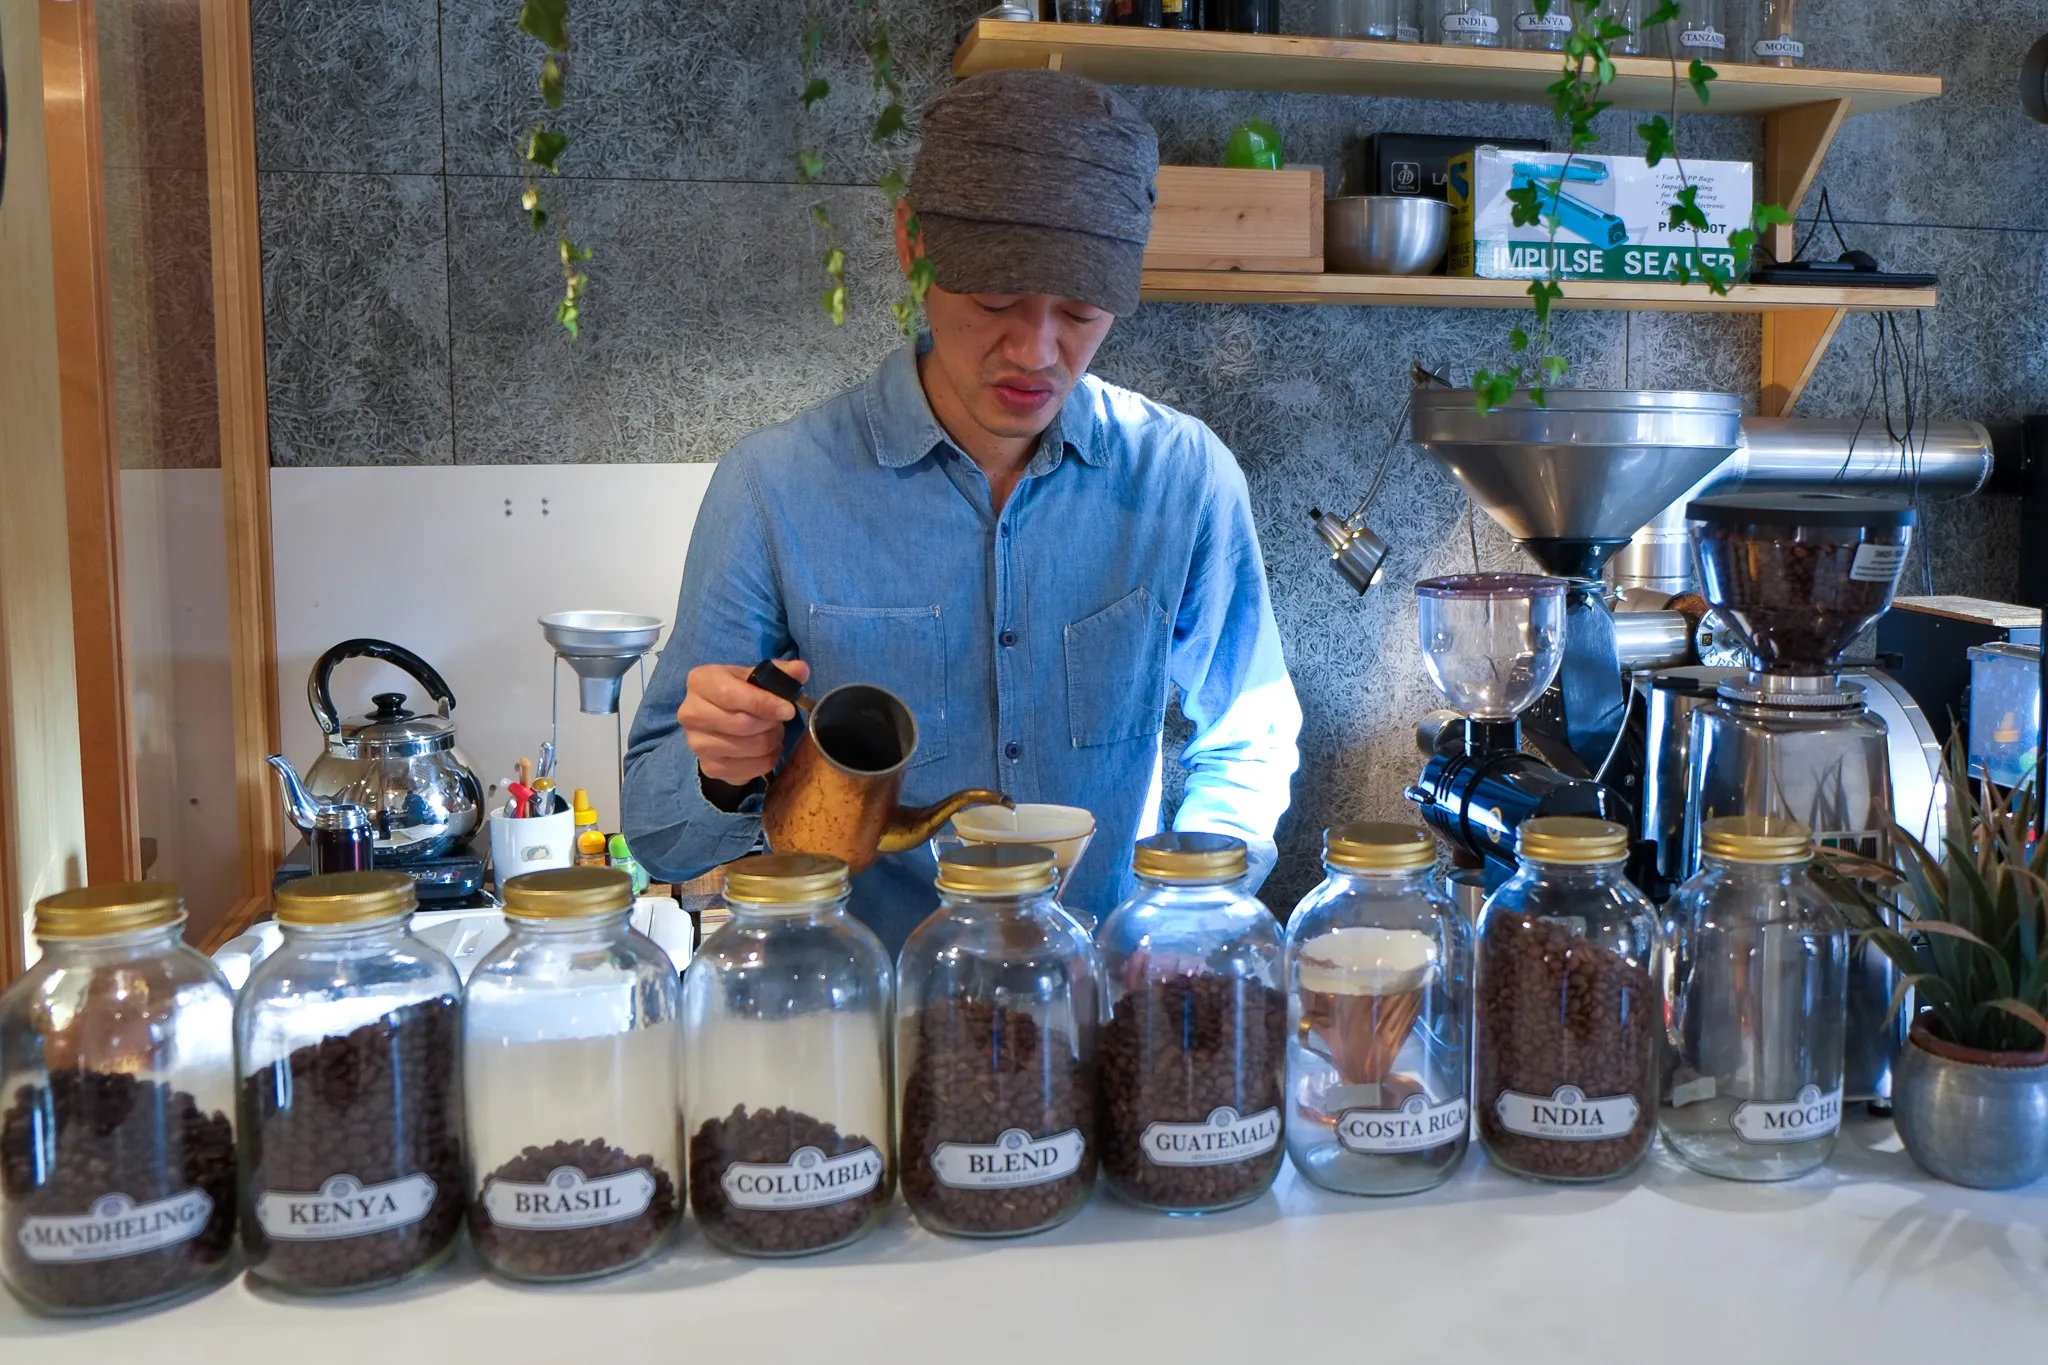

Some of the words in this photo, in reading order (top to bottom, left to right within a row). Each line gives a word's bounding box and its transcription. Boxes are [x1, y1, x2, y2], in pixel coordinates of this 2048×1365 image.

[1458, 16, 1488, 27] INDIA
[1764, 42, 1801, 52] MOCHA
[1493, 247, 1604, 273] IMPULSE
[1624, 250, 1736, 278] SEALER
[1349, 1119, 1423, 1139] COSTA
[1429, 1107, 1464, 1133] RICA
[1531, 1104, 1604, 1126] INDIA
[1763, 1100, 1838, 1130] MOCHA
[1156, 1119, 1276, 1152] GUATEMALA
[968, 1147, 1059, 1174] BLEND
[738, 1160, 873, 1195] COLUMBIA
[289, 1193, 398, 1225] KENYA
[515, 1186, 621, 1214] BRASIL
[34, 1202, 195, 1246] MANDHELING
